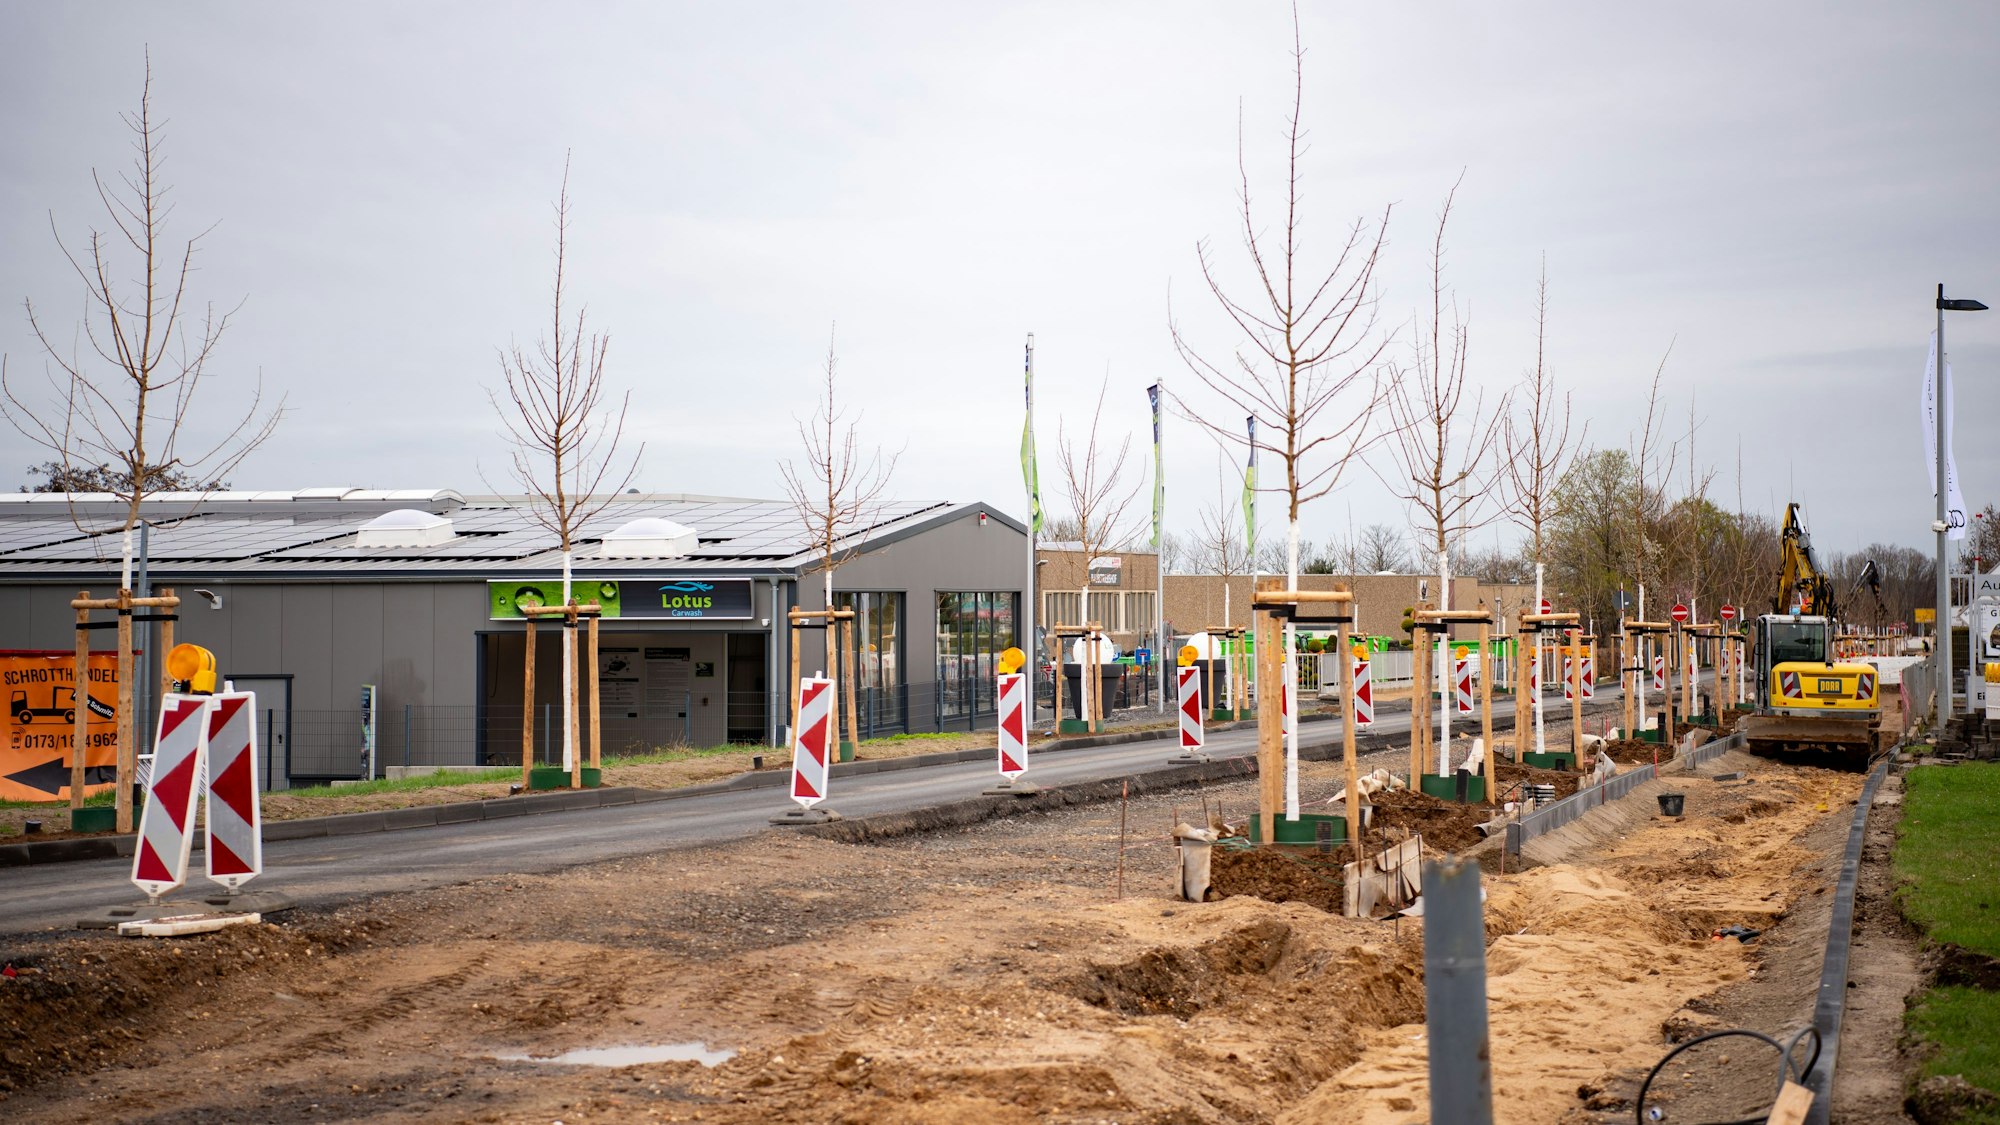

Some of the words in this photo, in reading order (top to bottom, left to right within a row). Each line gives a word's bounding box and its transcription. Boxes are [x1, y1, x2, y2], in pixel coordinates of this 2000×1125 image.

[661, 593, 713, 609] Lotus
[671, 609, 703, 617] Carwash
[4, 667, 119, 686] SCHROTTHNDEL
[90, 700, 114, 718] Schmitz
[24, 732, 118, 750] 0173/184962
